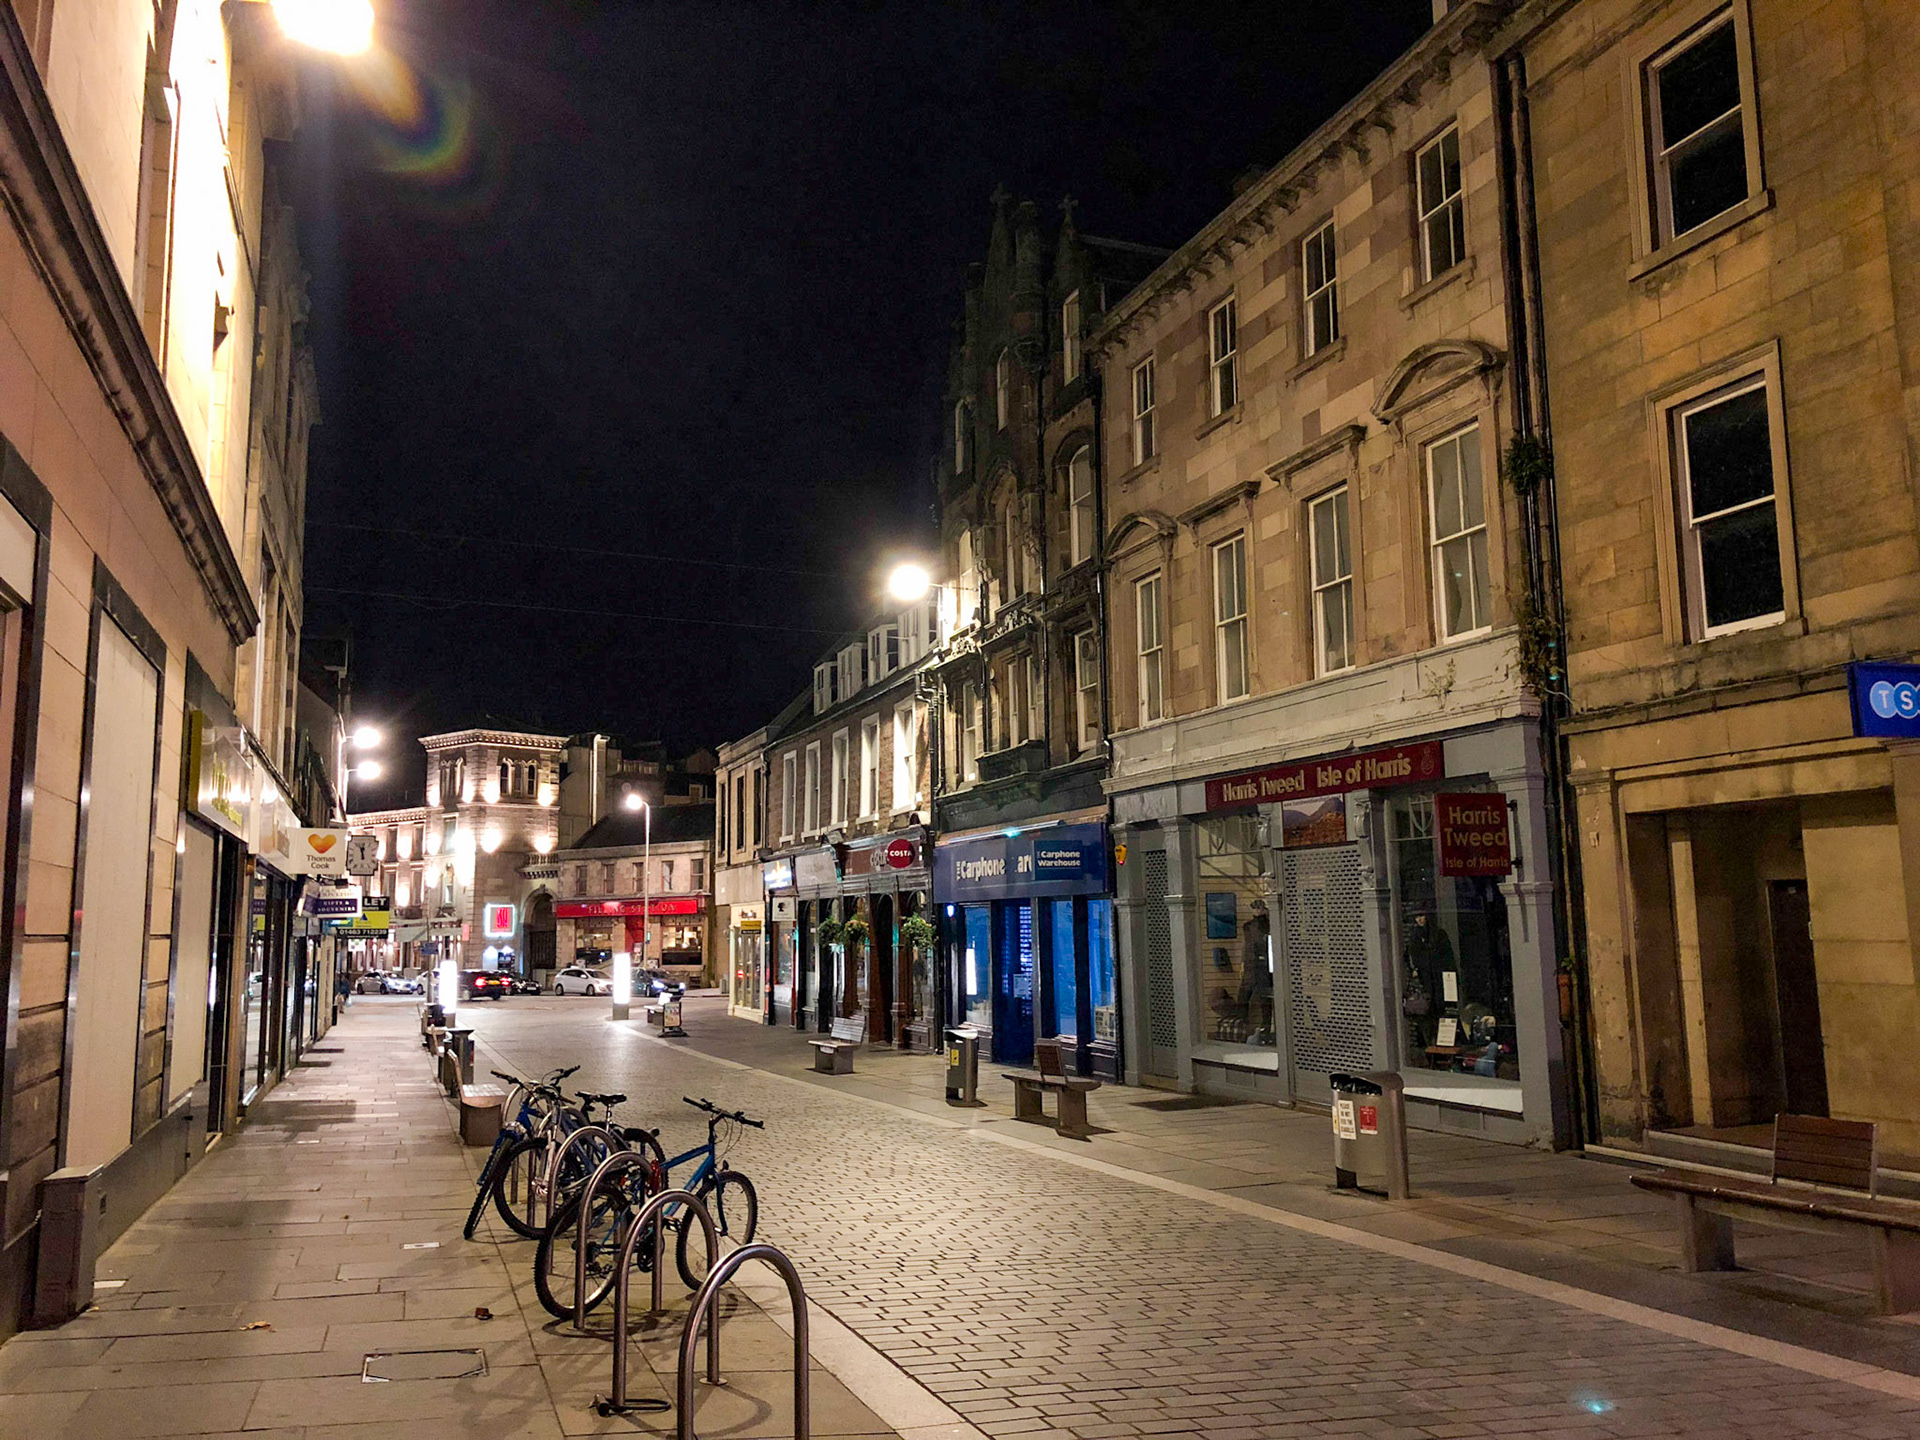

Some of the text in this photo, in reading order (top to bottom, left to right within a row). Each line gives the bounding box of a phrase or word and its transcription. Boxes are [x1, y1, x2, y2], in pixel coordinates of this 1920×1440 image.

[1878, 690, 1914, 711] TS
[1223, 779, 1258, 802] Harris
[1260, 769, 1305, 797] Tweed
[1316, 766, 1343, 788] Isle
[1345, 762, 1361, 785] of
[1365, 752, 1411, 780] Harris
[1448, 805, 1501, 825] Harris
[1444, 827, 1507, 847] Tweed
[306, 854, 336, 862] Thomas
[1037, 859, 1081, 867] Warehouse
[1041, 850, 1081, 860] Carphone
[1445, 856, 1509, 868] Isle of Harris
[960, 856, 1006, 881] Carphone
[364, 898, 387, 906] LET
